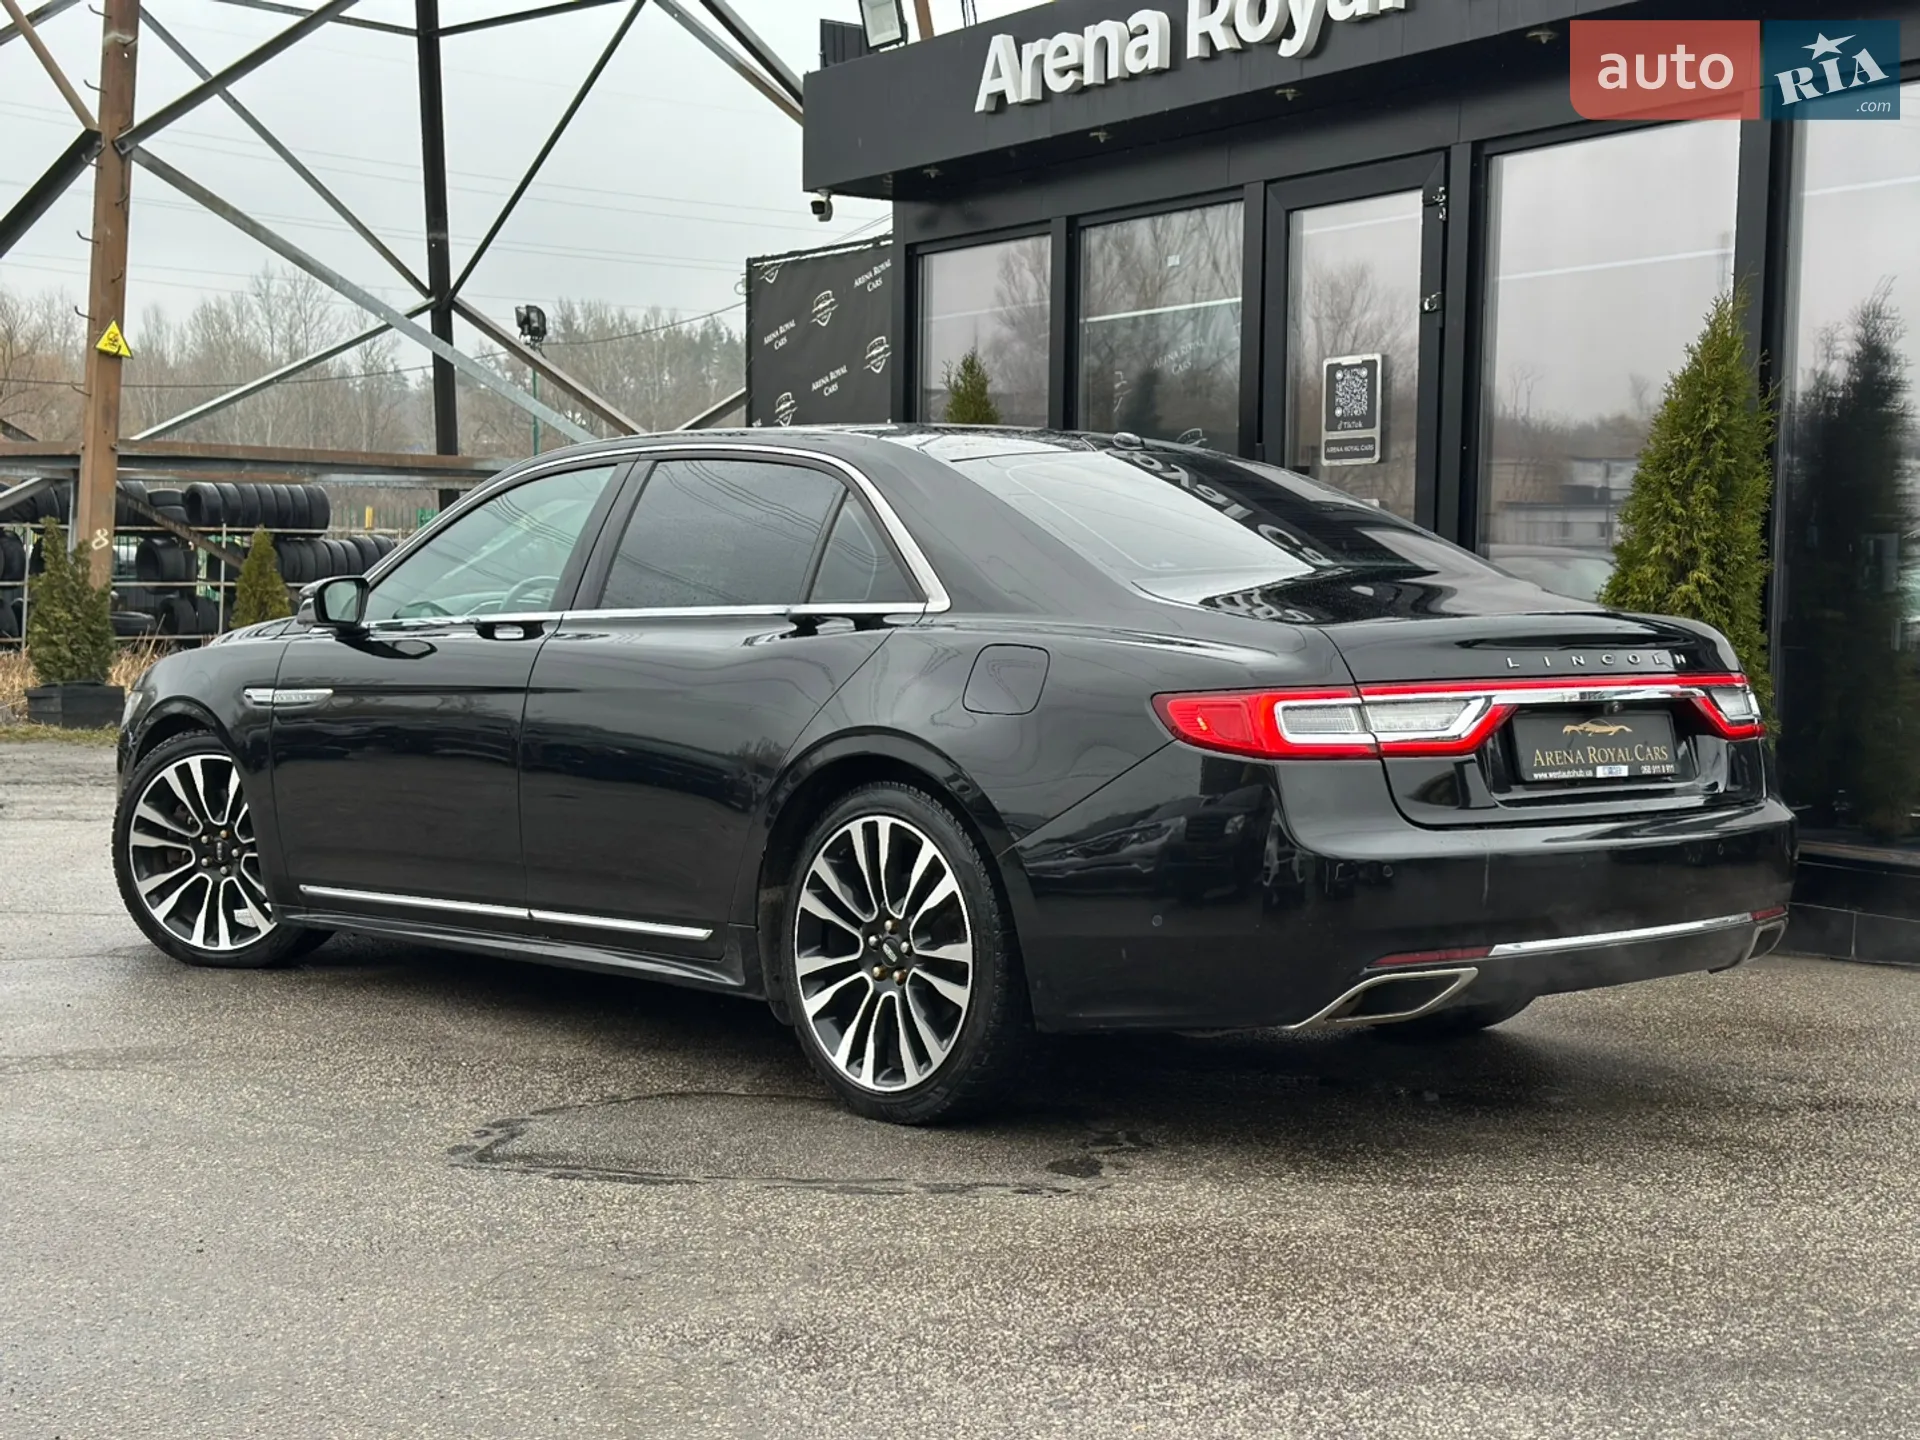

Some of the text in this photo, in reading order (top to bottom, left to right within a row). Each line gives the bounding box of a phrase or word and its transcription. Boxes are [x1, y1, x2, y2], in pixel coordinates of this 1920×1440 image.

[974, 0, 1406, 113] Arena Roy
[91, 527, 110, 551] 8
[1506, 653, 1687, 669] LINCOLN
[1533, 743, 1669, 767] ARENA ROYAL CARS
